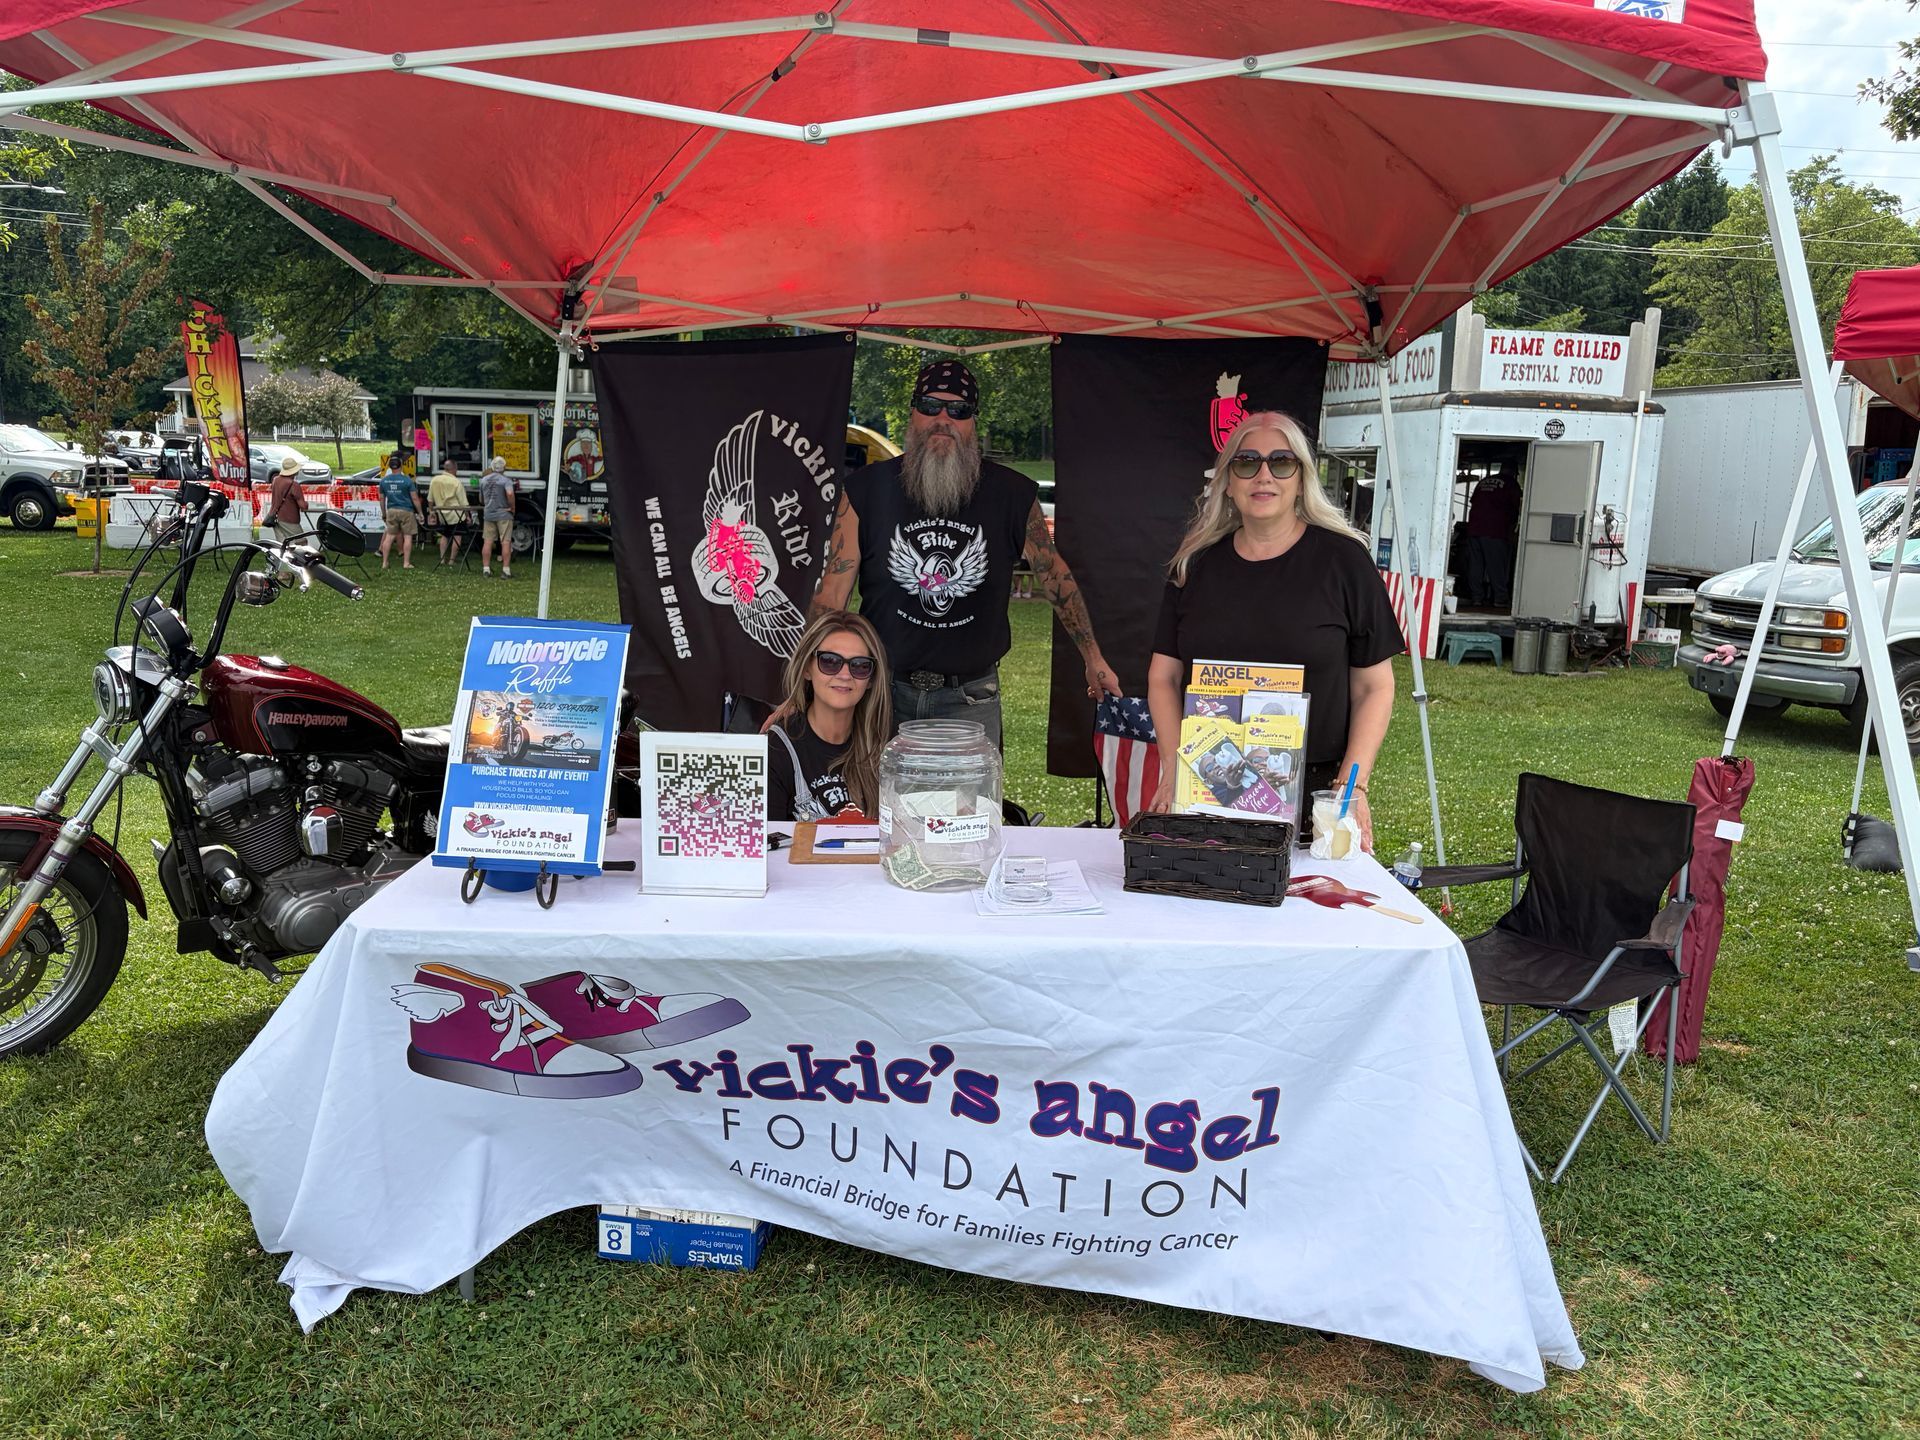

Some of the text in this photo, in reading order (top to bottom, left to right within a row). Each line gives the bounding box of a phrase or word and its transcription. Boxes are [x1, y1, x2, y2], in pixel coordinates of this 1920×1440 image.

[1490, 336, 1622, 360] FLAME GRILLED
[1354, 355, 1399, 389] FESTIAL
[1405, 346, 1434, 384] FOOD
[1501, 363, 1603, 385] FESTIVAL FOOD
[186, 310, 233, 460] CHICKEN
[770, 488, 813, 569] Ride
[947, 520, 976, 536] angel
[917, 531, 958, 550] Ride
[645, 497, 692, 660] WE CAN ALL BE ANGELS
[897, 609, 908, 619] WE
[908, 616, 922, 625] CAN
[949, 615, 974, 628] ANGELS
[487, 638, 609, 665] Motorcycle
[503, 663, 573, 696] Raffle
[1200, 666, 1254, 680] ANGEL
[1200, 678, 1228, 687] NEWS
[556, 703, 600, 714] SPORTSTER
[472, 766, 589, 781] PURCHASE TICKETS AT ANY EVENT!
[496, 840, 568, 850] FOUNDATION
[540, 831, 573, 842] angel
[1029, 1080, 1281, 1174] angel
[722, 1108, 1248, 1218] FOUNDATION
[728, 1159, 1238, 1258] A Financial Bridge for Families Fighting Cancer
[606, 1229, 623, 1250] 8
[690, 1240, 743, 1251] Multiuse Paper
[688, 1250, 743, 1265] STAPLES
